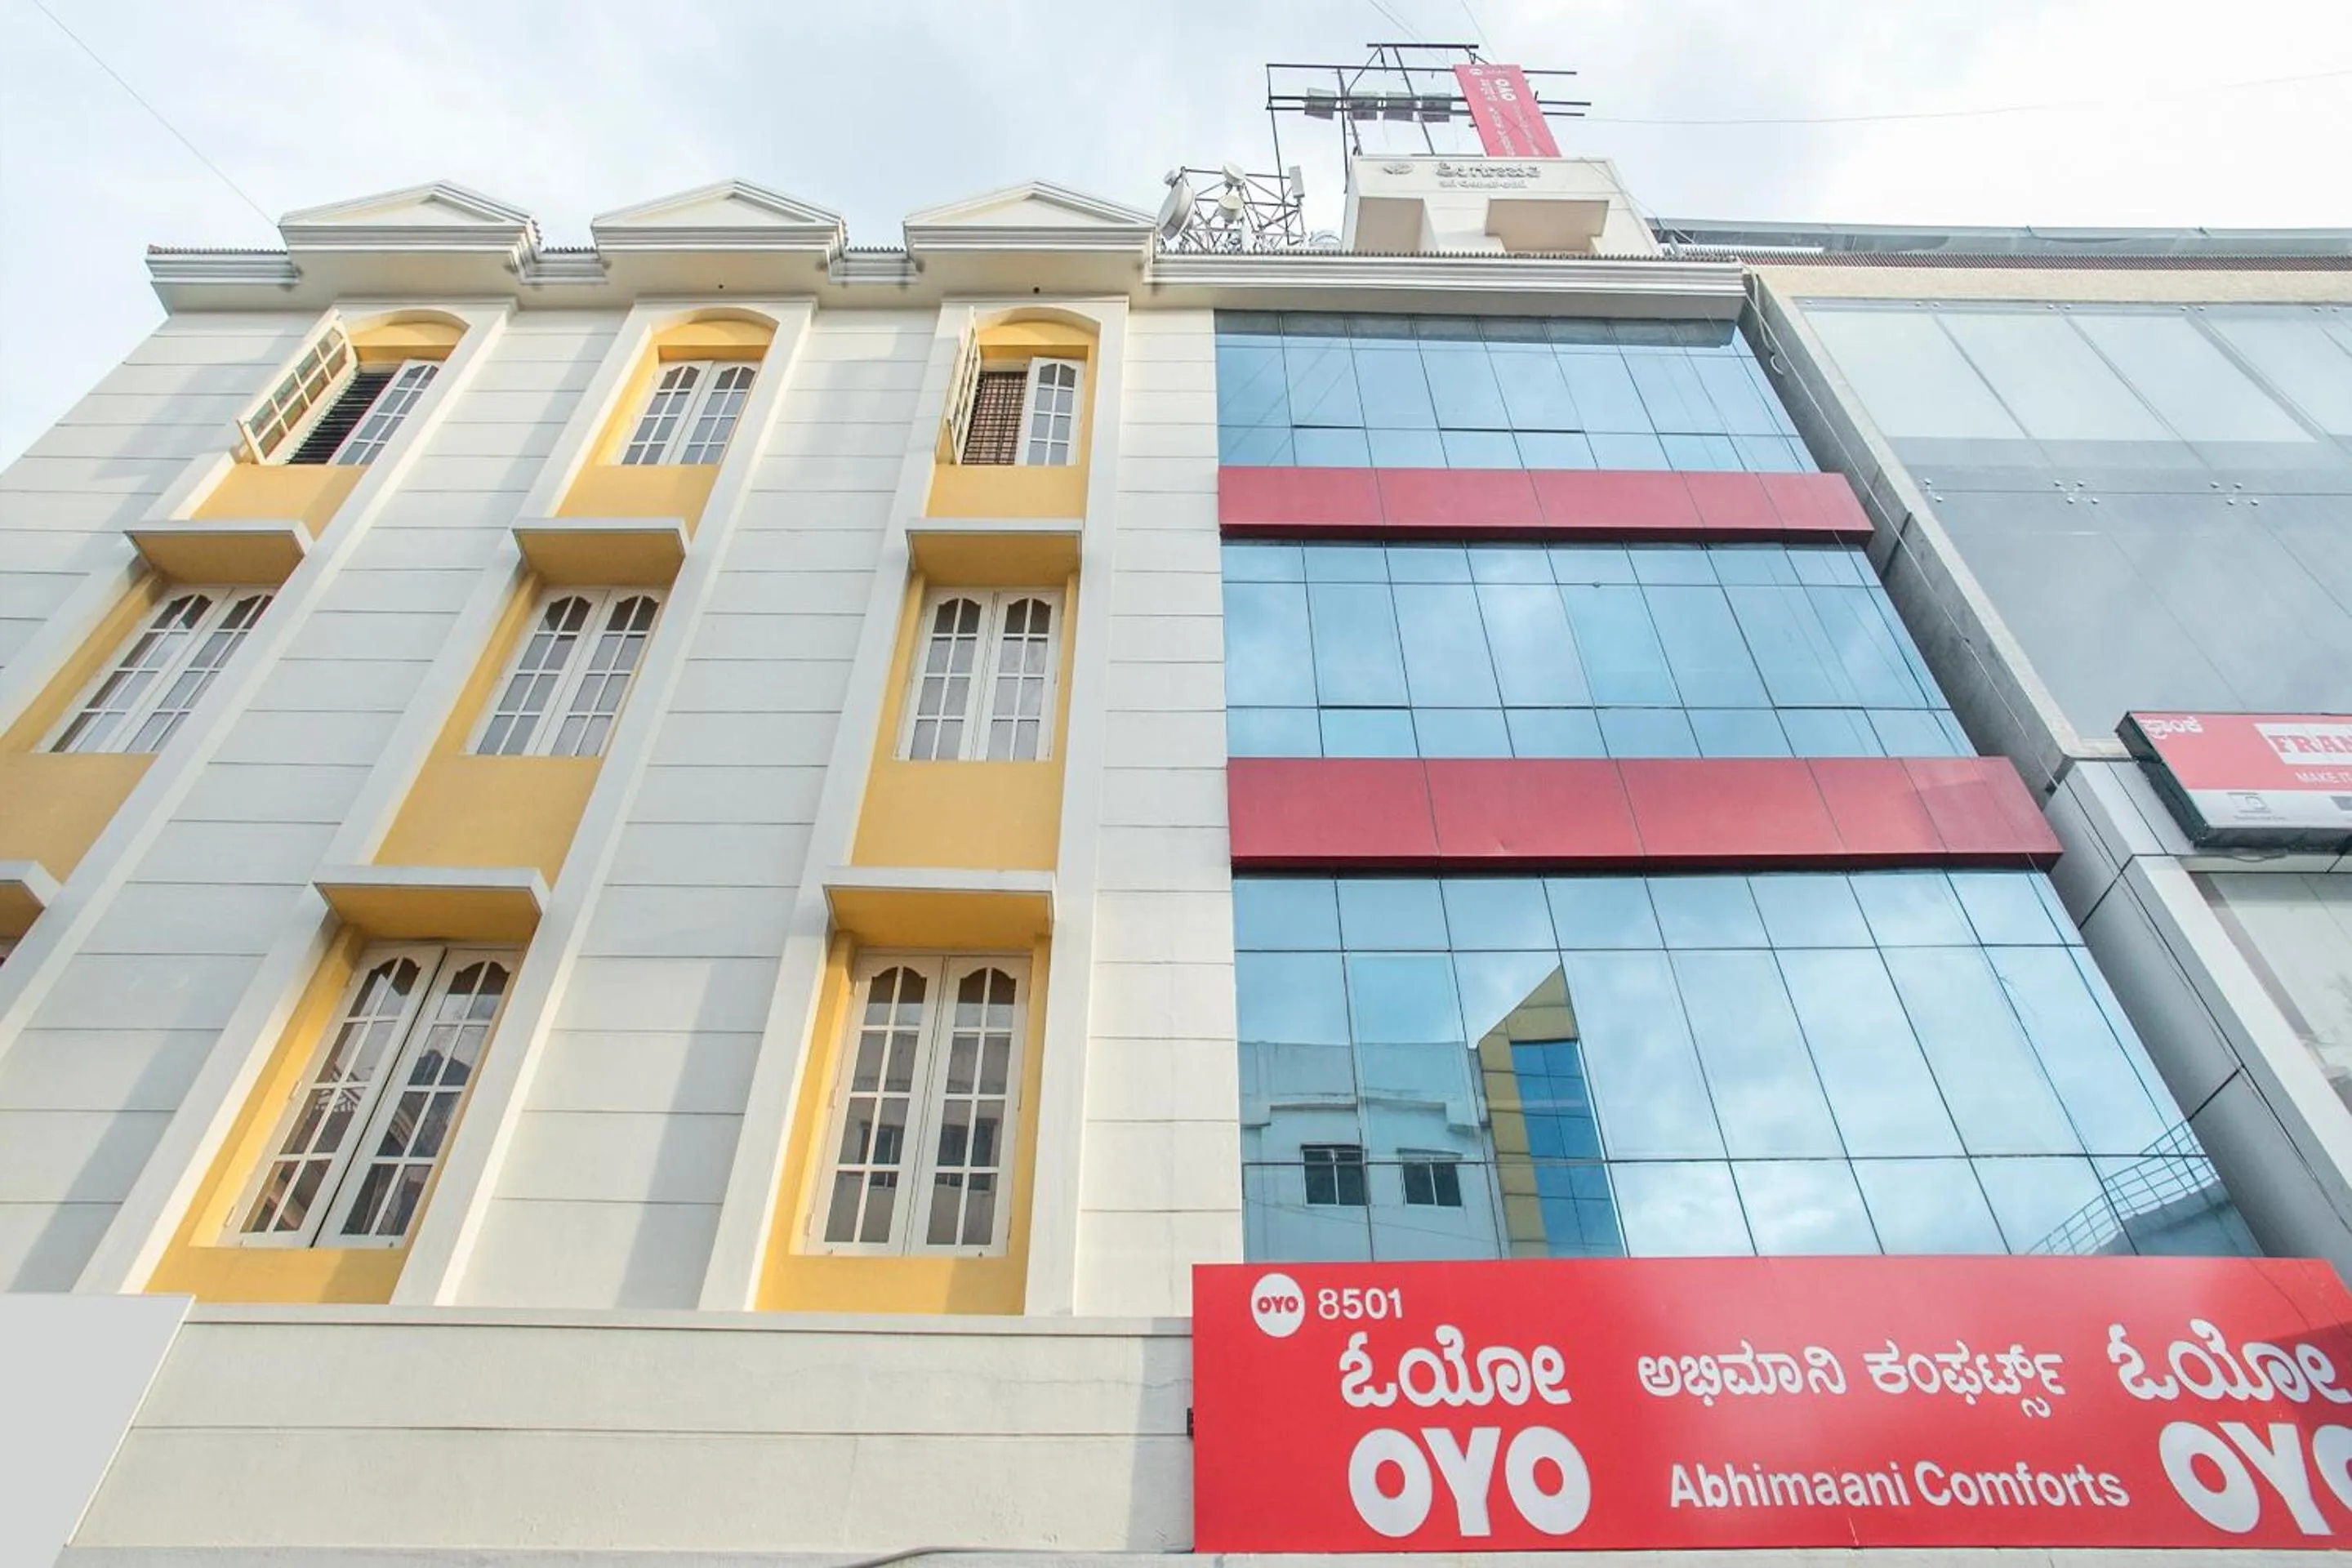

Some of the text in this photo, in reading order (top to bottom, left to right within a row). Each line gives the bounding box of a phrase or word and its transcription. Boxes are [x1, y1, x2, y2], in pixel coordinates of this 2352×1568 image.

[1257, 1287, 1404, 1321] OYO 8501
[1339, 1324, 1573, 1408] ಓಯೋ
[1637, 1338, 1847, 1407] ಅಭಿಮಾನಿ
[1348, 1425, 1592, 1538] OYO
[1670, 1459, 2131, 1508] Abhimaani Comforts
